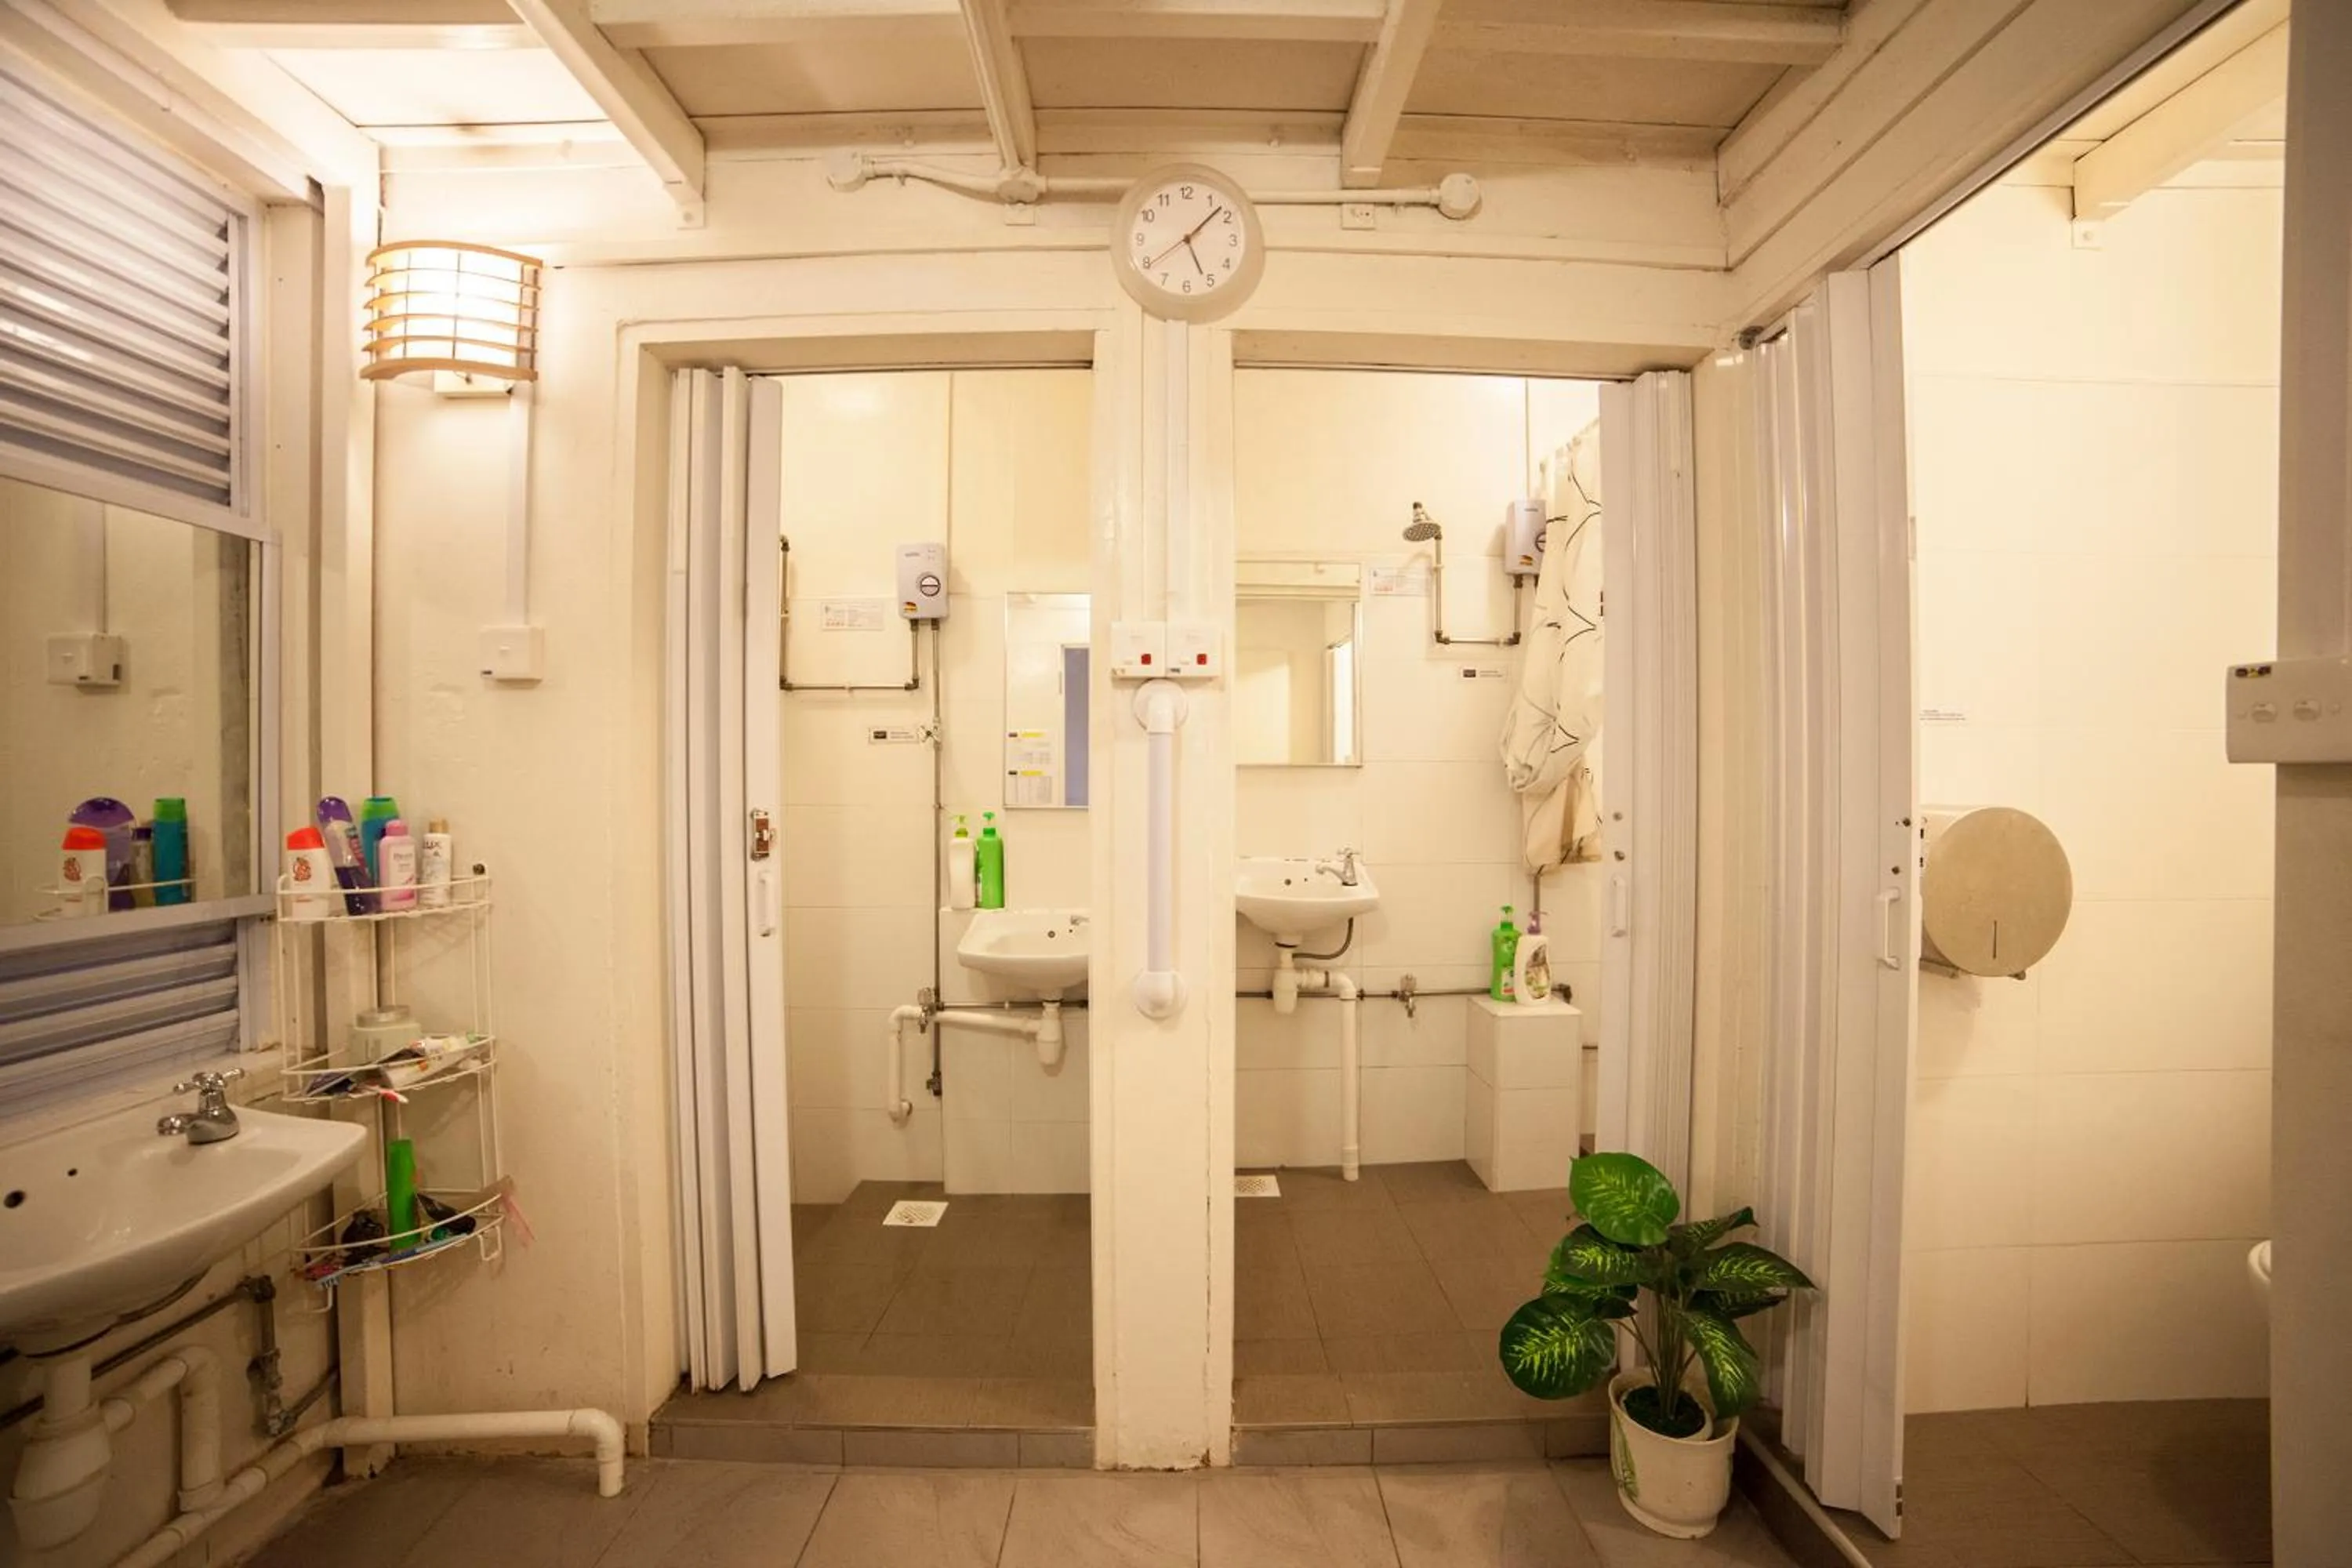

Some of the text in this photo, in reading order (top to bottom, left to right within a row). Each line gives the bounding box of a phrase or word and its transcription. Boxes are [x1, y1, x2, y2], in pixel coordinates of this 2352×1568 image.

[1179, 186, 1193, 200] 12
[1158, 194, 1170, 207] 11
[1207, 194, 1213, 207] 1
[1142, 209, 1156, 223] 10
[1223, 210, 1232, 224] 2
[1136, 232, 1145, 246] 9
[1229, 234, 1238, 247] 3
[1142, 256, 1151, 270] 8
[1222, 257, 1231, 270] 4
[1160, 272, 1169, 286] 7
[1206, 274, 1215, 288] 5
[1182, 280, 1191, 293] 6
